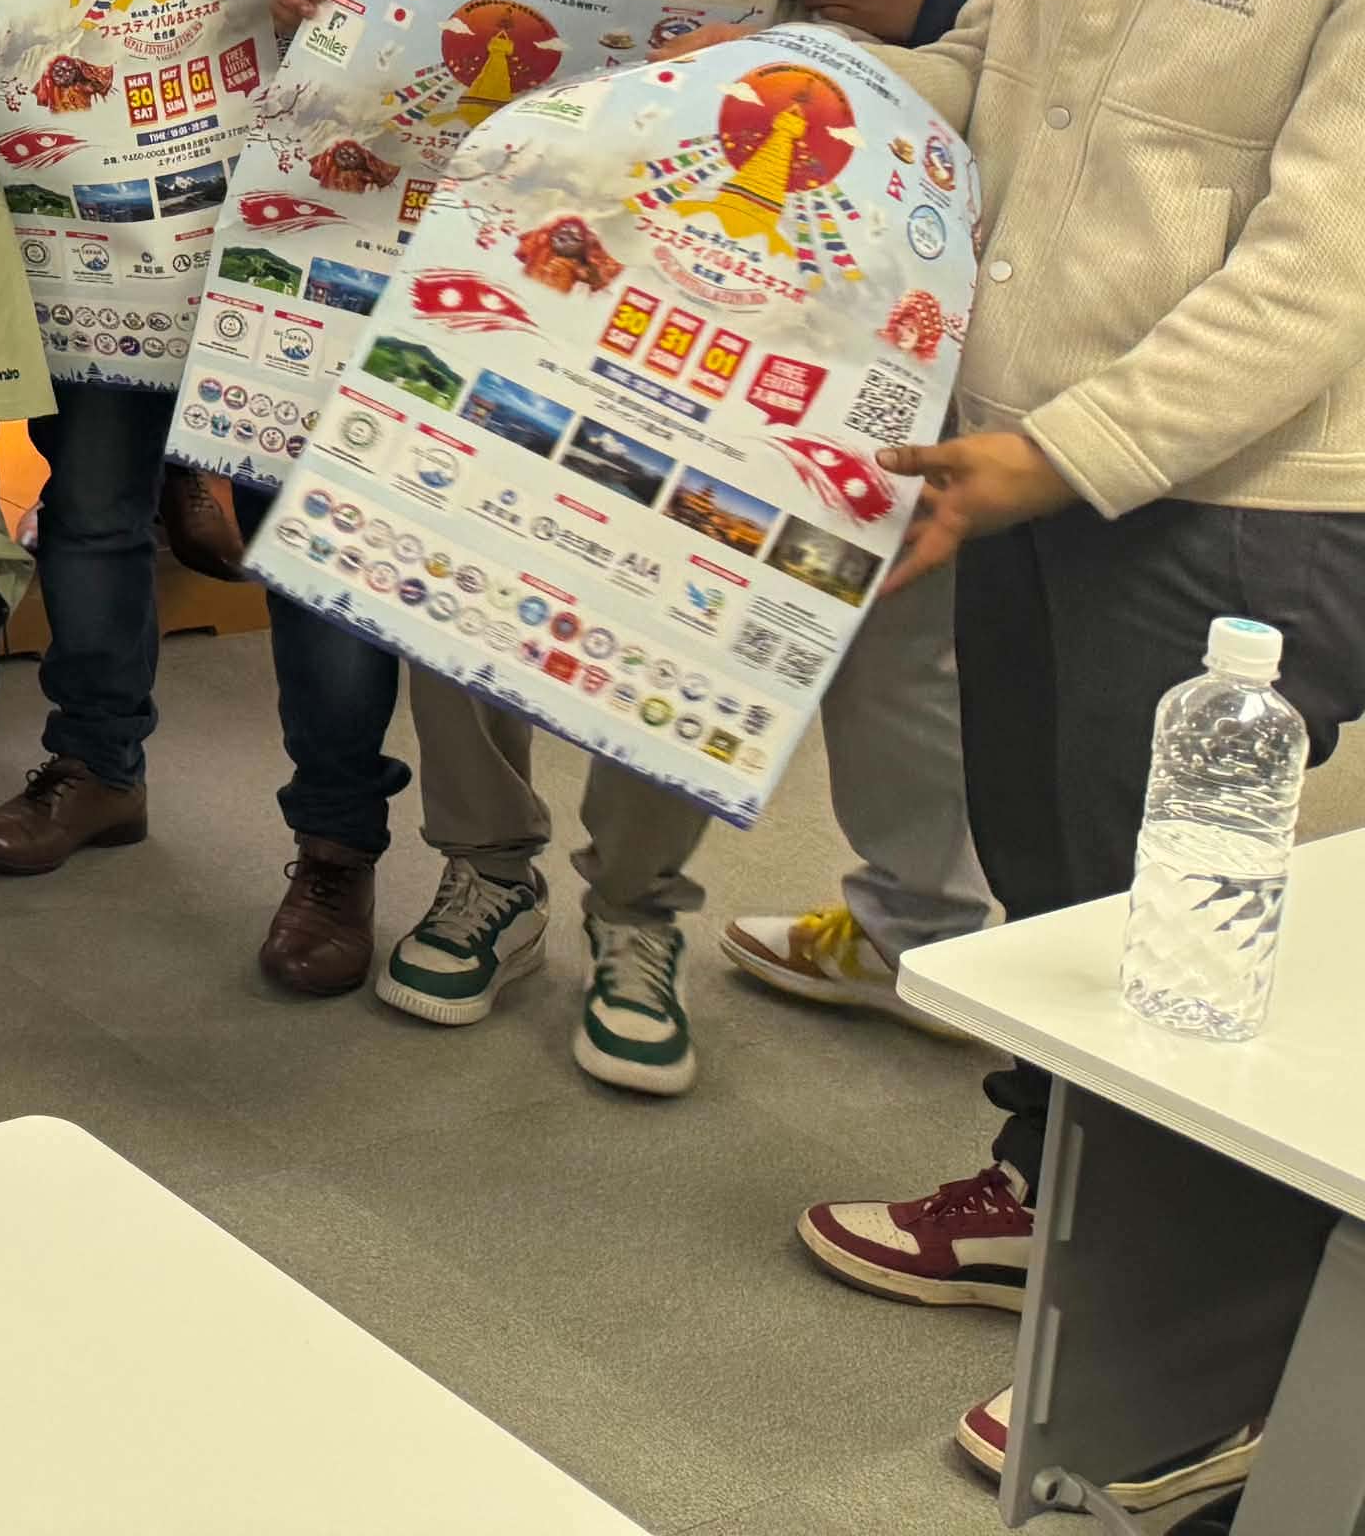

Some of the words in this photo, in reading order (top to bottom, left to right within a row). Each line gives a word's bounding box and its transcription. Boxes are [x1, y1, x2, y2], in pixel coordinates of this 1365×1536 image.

[309, 26, 348, 56] Smiles
[164, 80, 181, 100] 31
[192, 71, 210, 91] 01
[129, 88, 153, 107] 30
[165, 100, 184, 113] SUN
[133, 108, 153, 120] SAT
[405, 192, 430, 208] 30
[613, 304, 650, 336] 30
[659, 327, 693, 357] 31
[705, 347, 739, 378] 01
